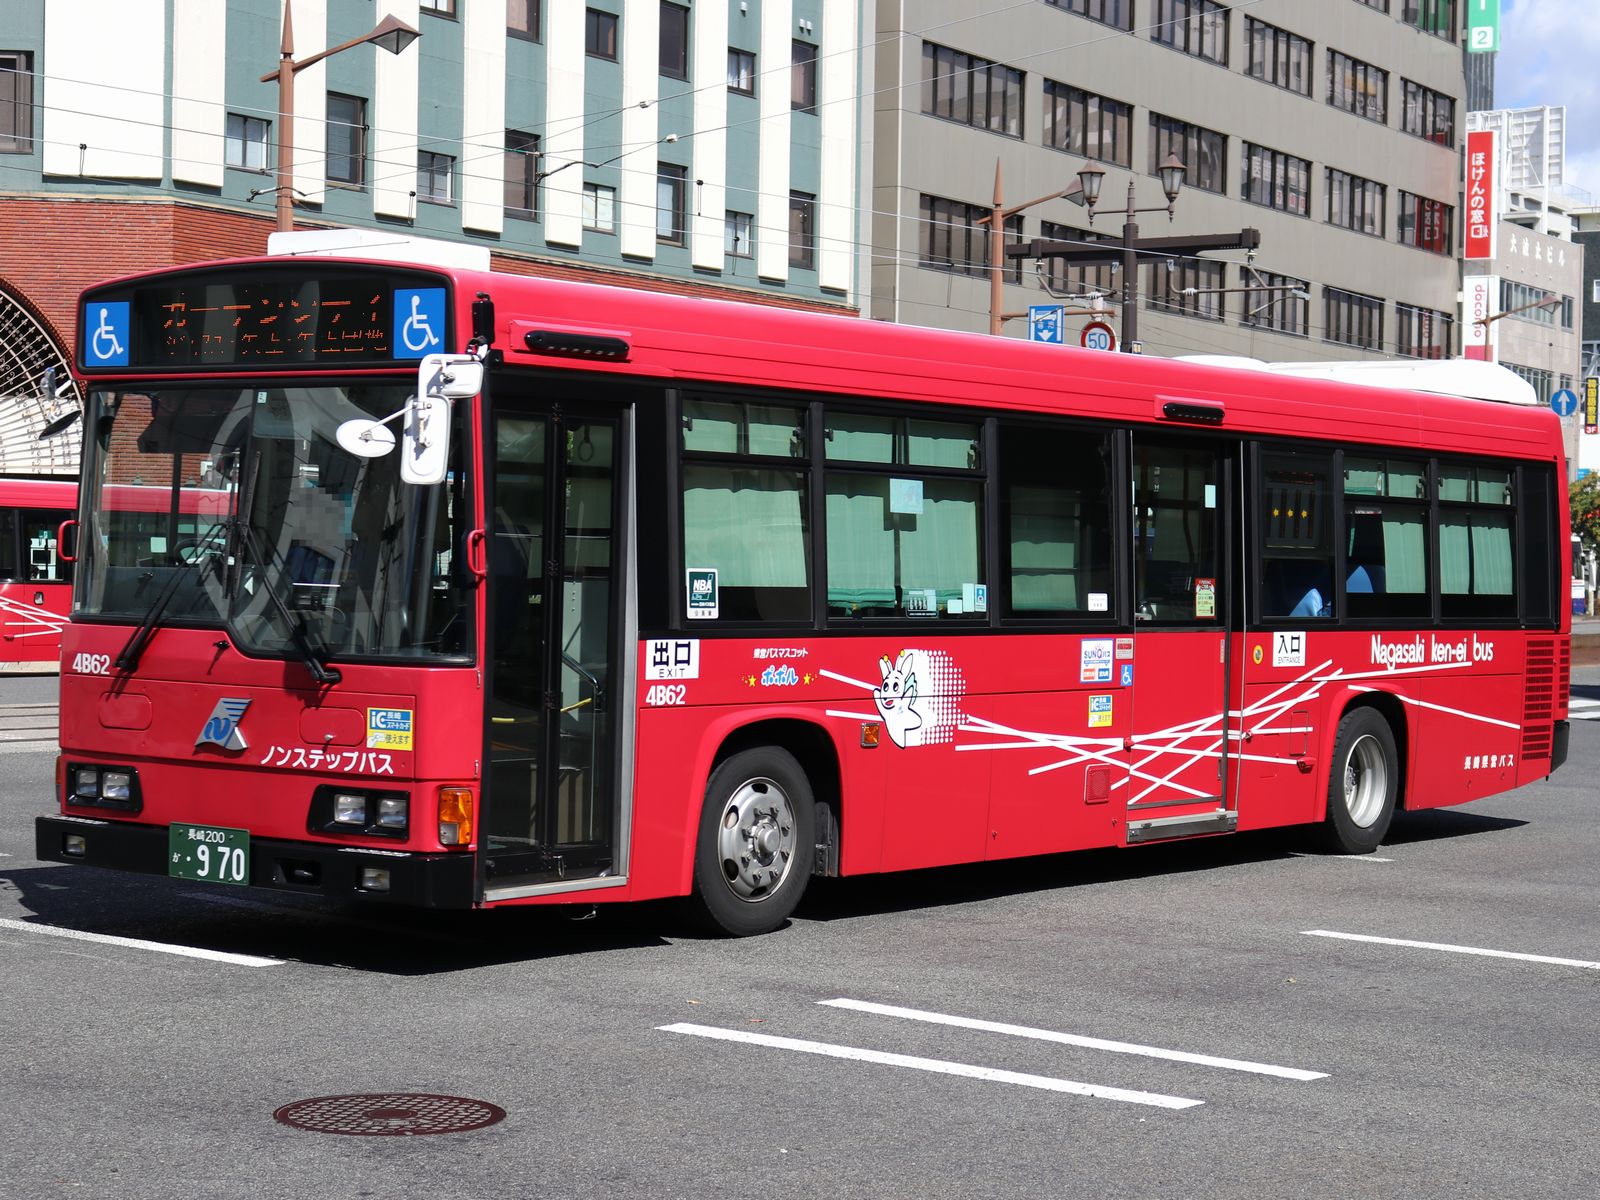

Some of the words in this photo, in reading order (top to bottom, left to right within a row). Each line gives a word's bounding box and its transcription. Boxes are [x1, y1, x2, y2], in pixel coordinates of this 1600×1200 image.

[1477, 30, 1488, 45] 2
[1471, 152, 1486, 238] ほけんの窓口
[1088, 333, 1108, 350] 50
[1586, 426, 1597, 434] 3F
[693, 578, 713, 592] NBA
[653, 641, 691, 667] 出口
[753, 648, 809, 659] 県営バスマスコット
[1278, 634, 1301, 654] 入口
[1371, 633, 1425, 671] Nagasaki
[1431, 633, 1467, 662] ken-ei
[1473, 632, 1494, 662] bus
[72, 652, 111, 675] 4B62
[659, 668, 685, 678] EXIT
[761, 664, 799, 687] ポポル
[645, 684, 687, 706] 4B62
[261, 745, 394, 774] ノンステップバス
[1463, 754, 1514, 770] 長崎県営バス
